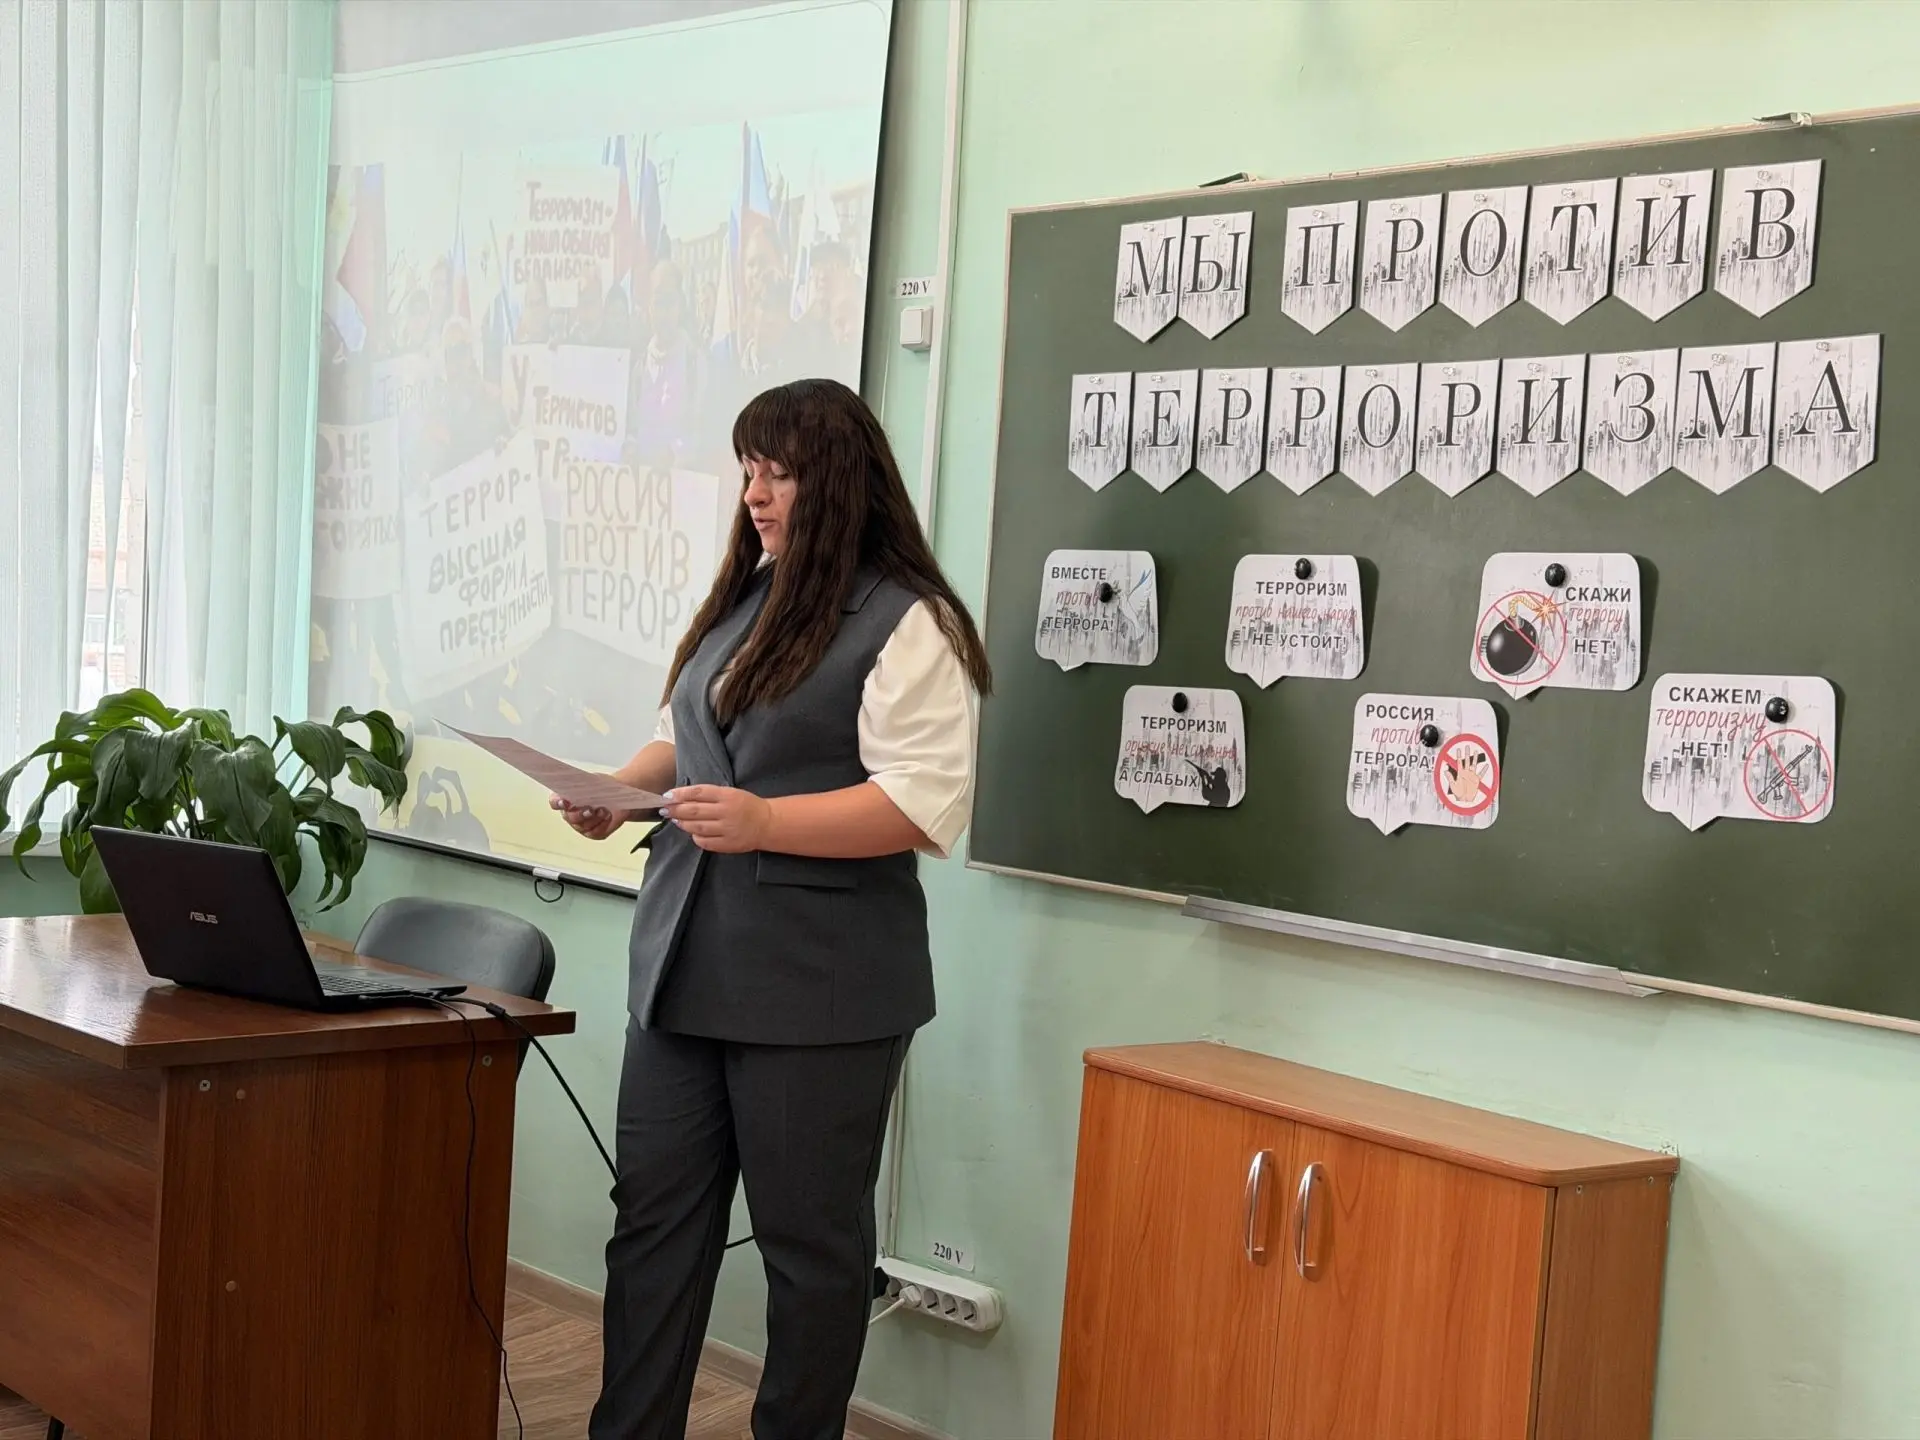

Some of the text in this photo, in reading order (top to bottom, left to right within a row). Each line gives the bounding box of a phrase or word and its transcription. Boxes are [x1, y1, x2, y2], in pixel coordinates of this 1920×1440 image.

[1123, 187, 1796, 298] МЫ ПРОТИВ
[901, 280, 931, 296] 220 V
[1083, 360, 1858, 450] ТЕРРОРИЗМА
[567, 464, 672, 531] РОССИЯ
[428, 515, 527, 594] ВЫСШАЯ
[564, 522, 690, 592] ПРОТИВ
[459, 551, 528, 607] ФОРМА
[1051, 566, 1107, 581] ВМЕСТЕ
[1256, 581, 1347, 597] ТЕРРОРИЗМ
[1565, 586, 1632, 603] СКАЖИ
[561, 567, 695, 649] ТЕРРОР
[1235, 597, 1274, 624] против
[1046, 616, 1114, 632] ТЕРРОРА!
[1569, 606, 1624, 634] террору
[1252, 633, 1347, 650] НЕ УСТОИТ!
[1574, 639, 1616, 655] НЕТ!
[1669, 686, 1761, 704] СКАЖЕМ
[1366, 704, 1434, 721] РОССИЯ
[1140, 716, 1227, 733] ТЕРРОРИЗМ
[1656, 707, 1767, 743] терроризму
[1371, 718, 1424, 752] против
[1681, 741, 1728, 758] НЕТ!
[1354, 750, 1435, 769] ТЕРРОРА!
[1119, 770, 1199, 787] А СЛАБЫХ
[190, 911, 218, 924] ASUS
[933, 1242, 964, 1264] 220 V
